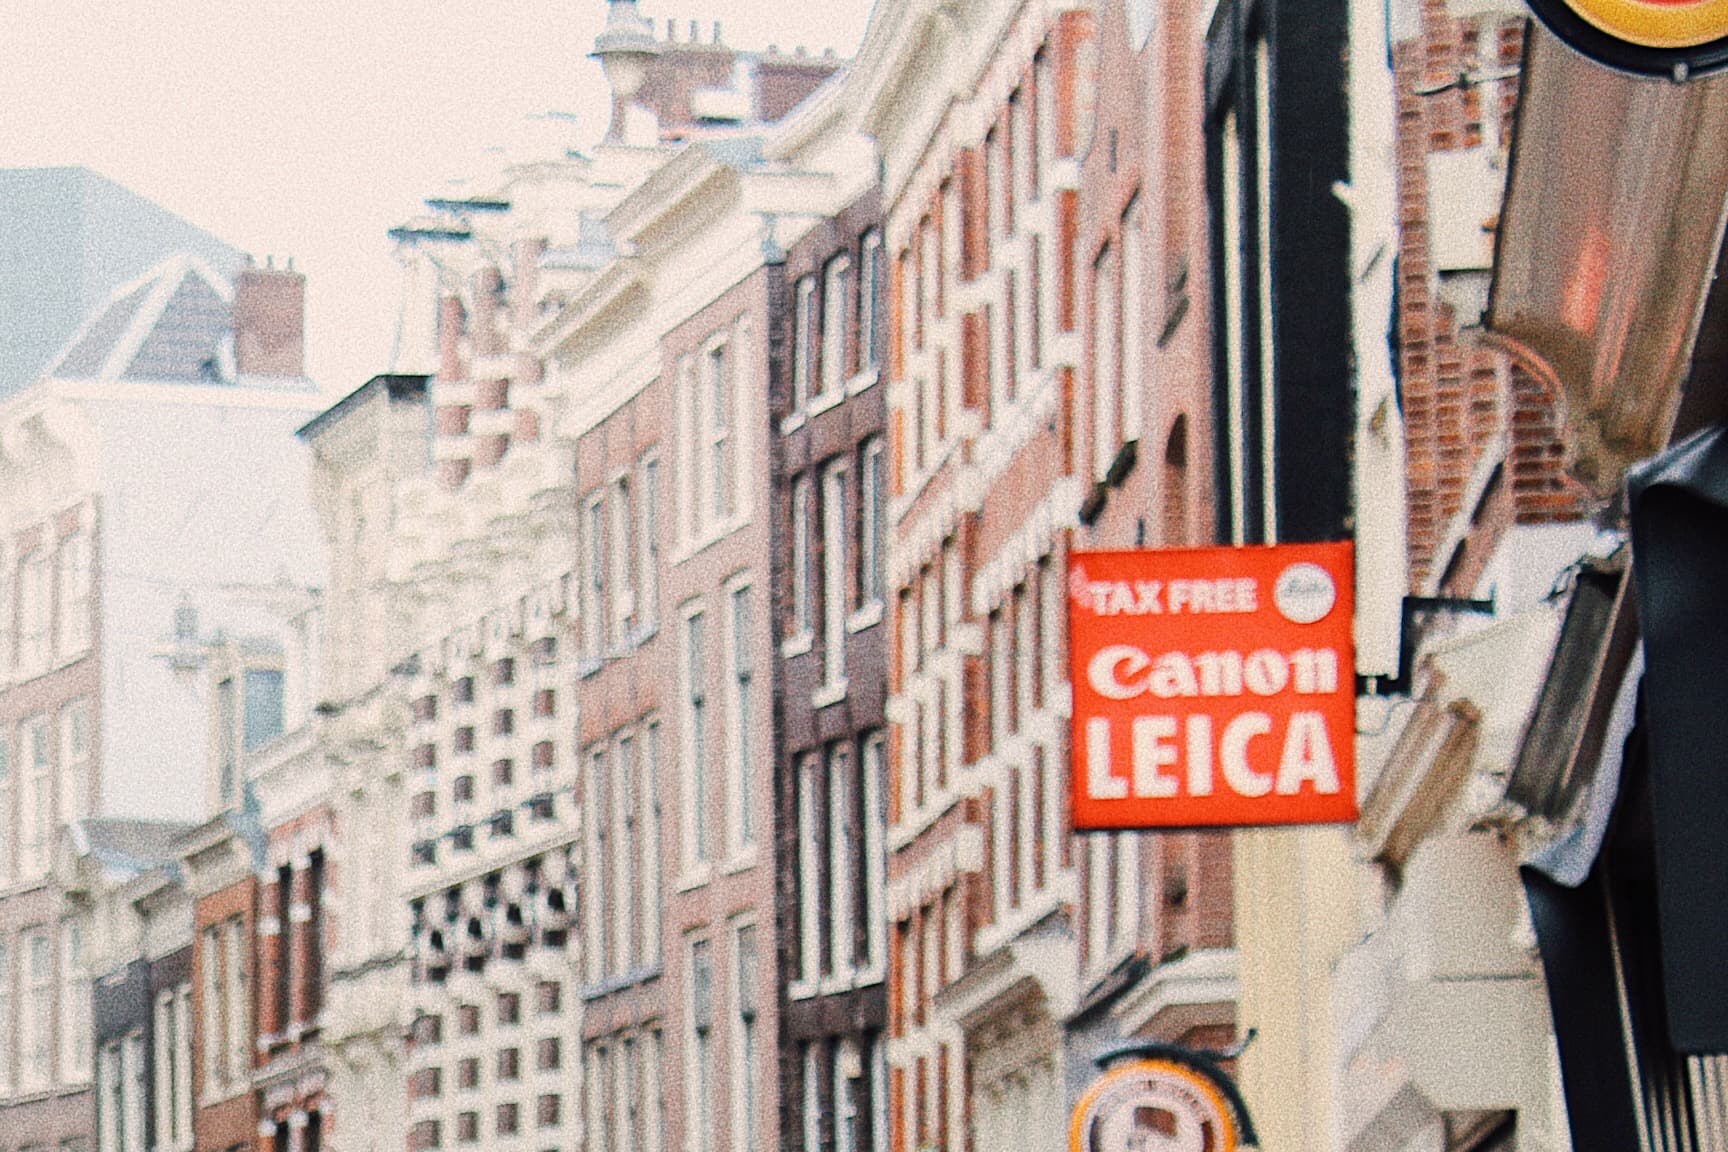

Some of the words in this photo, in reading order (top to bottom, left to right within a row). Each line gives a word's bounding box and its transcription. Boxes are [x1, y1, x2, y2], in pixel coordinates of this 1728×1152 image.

[1089, 580, 1163, 617] TAX
[1167, 577, 1259, 615] FREE
[1086, 644, 1339, 700] Canon
[1085, 711, 1342, 800] LEICA
